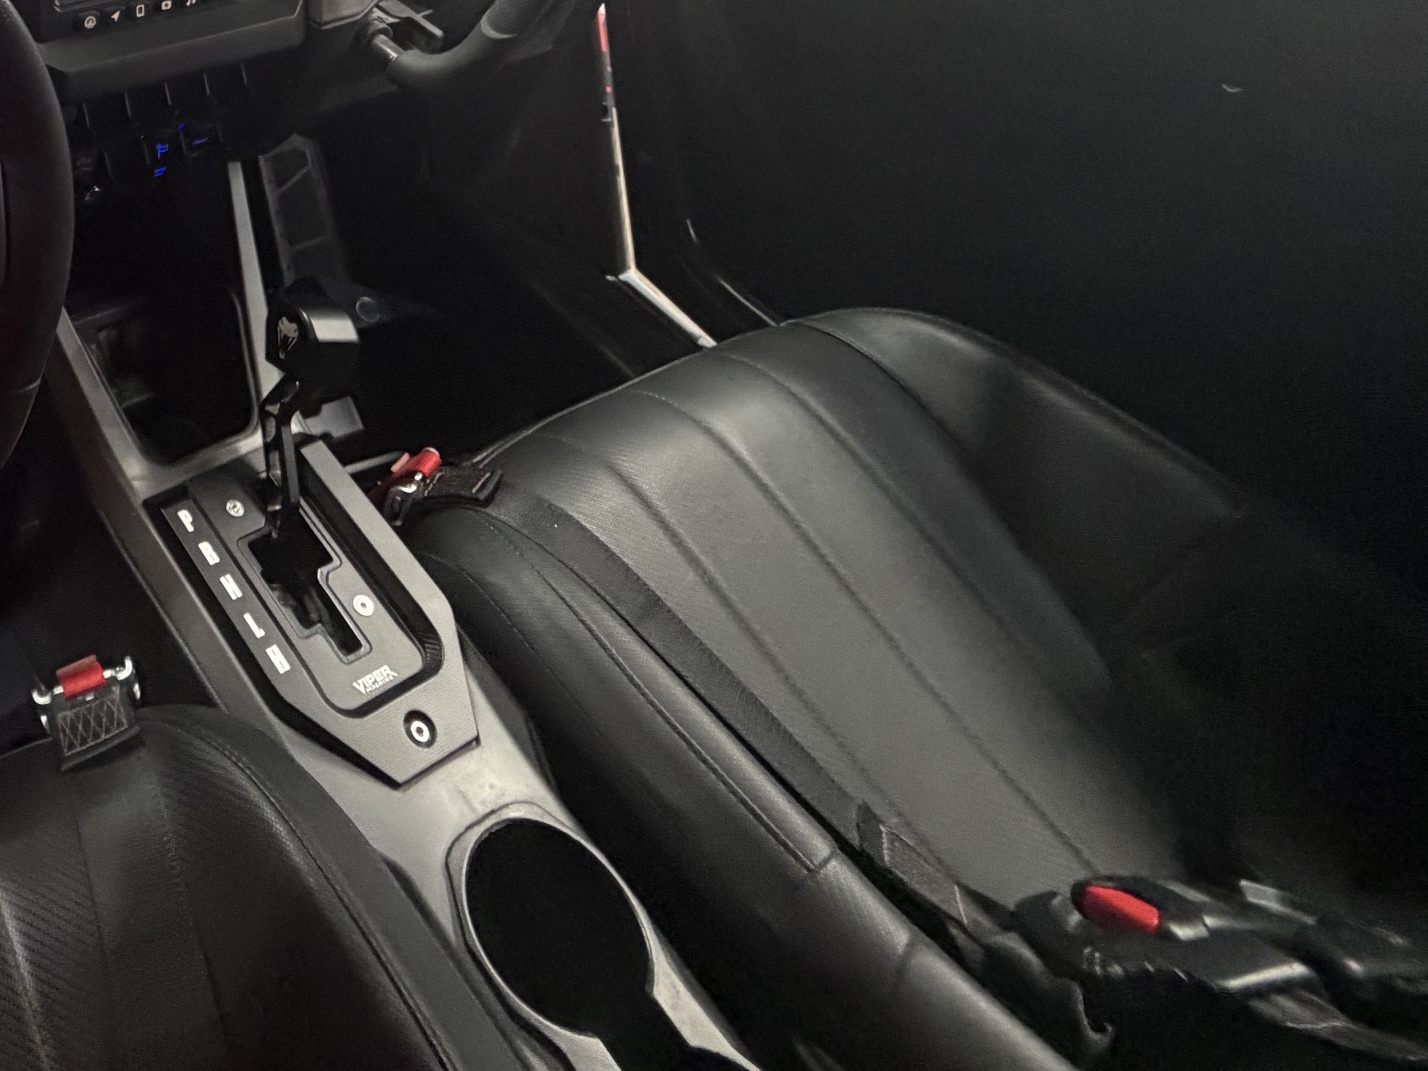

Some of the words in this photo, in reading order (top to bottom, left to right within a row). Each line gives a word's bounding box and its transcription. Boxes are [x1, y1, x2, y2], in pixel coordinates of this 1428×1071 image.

[177, 509, 194, 532] P
[198, 541, 220, 565] R
[243, 612, 265, 639] L
[265, 644, 291, 674] H
[352, 665, 398, 695] VIPER
